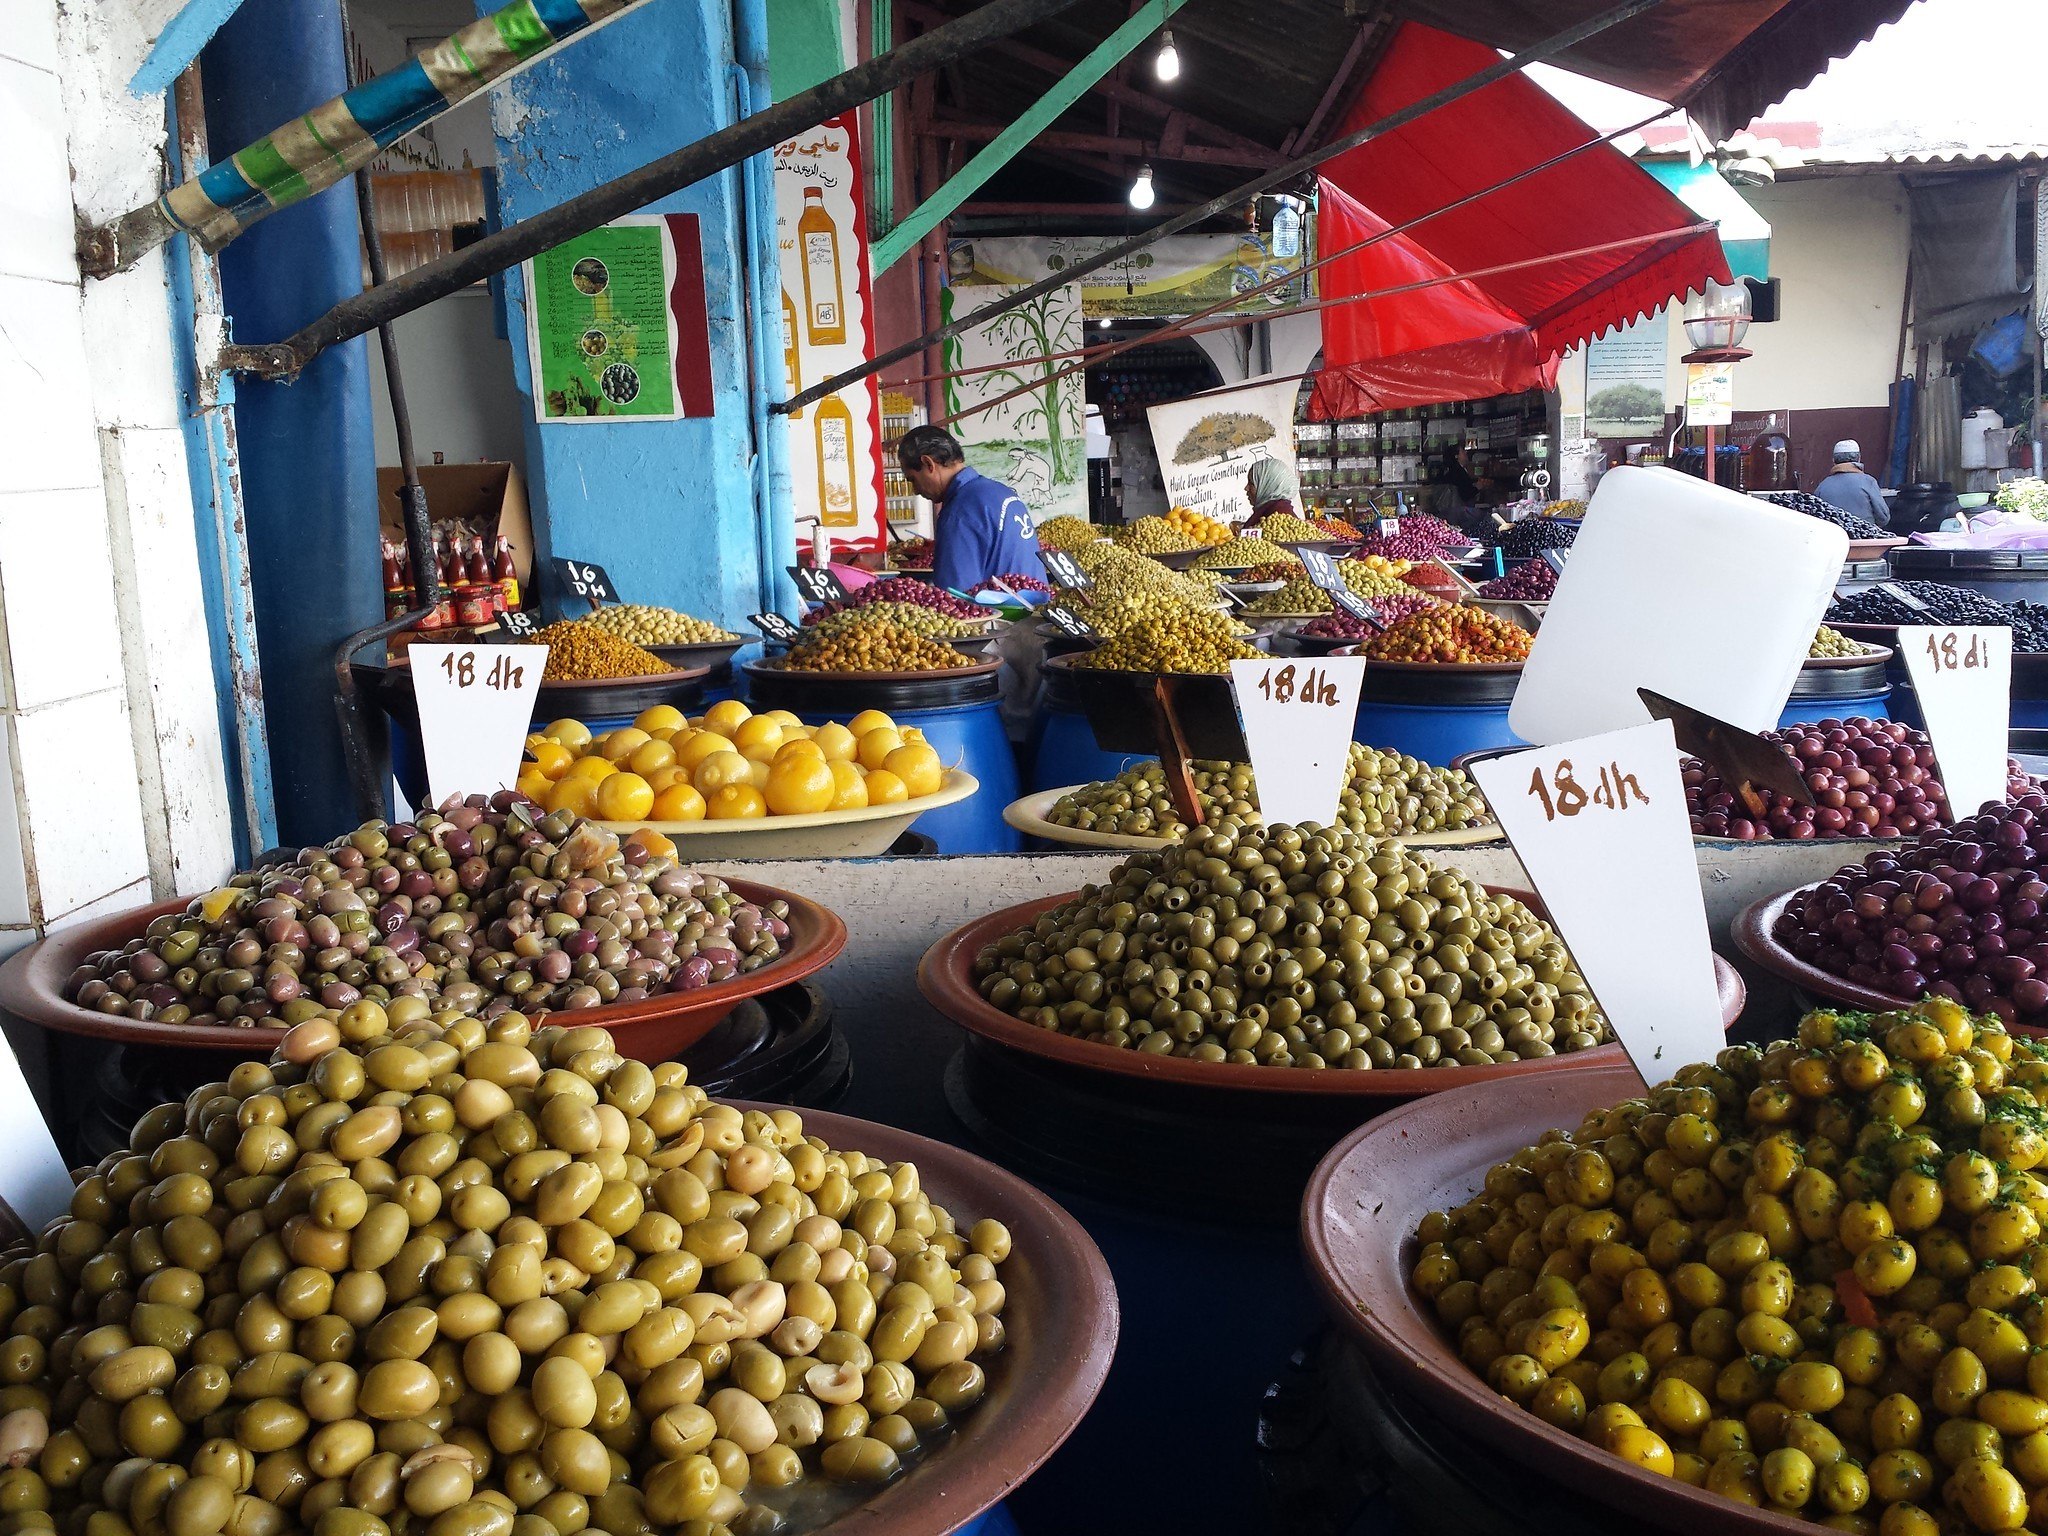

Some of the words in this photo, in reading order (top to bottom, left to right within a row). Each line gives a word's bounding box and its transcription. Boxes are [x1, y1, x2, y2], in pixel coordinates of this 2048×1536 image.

[1170, 475, 1186, 493] Huile
[1386, 521, 1396, 529] 18
[1046, 552, 1075, 576] 18
[1307, 550, 1328, 574] 18
[567, 560, 596, 584] 16
[800, 567, 830, 588] 16
[1061, 572, 1087, 588] DH
[1315, 572, 1336, 586] DH
[572, 580, 606, 598] DH
[811, 584, 840, 600] DH
[1336, 591, 1365, 608] 18
[501, 611, 532, 627] 18
[1047, 607, 1074, 626] 18
[1354, 604, 1376, 618] DH
[755, 612, 786, 630] 18
[1064, 620, 1090, 636] DH
[508, 625, 538, 636] DH
[771, 625, 800, 638] DH
[1926, 632, 1958, 674] 18
[441, 652, 476, 688] 18
[486, 654, 524, 690] dh
[1258, 664, 1296, 704] 18
[1300, 666, 1340, 706] dh
[1528, 758, 1589, 822] 18
[1594, 761, 1650, 810] dh
